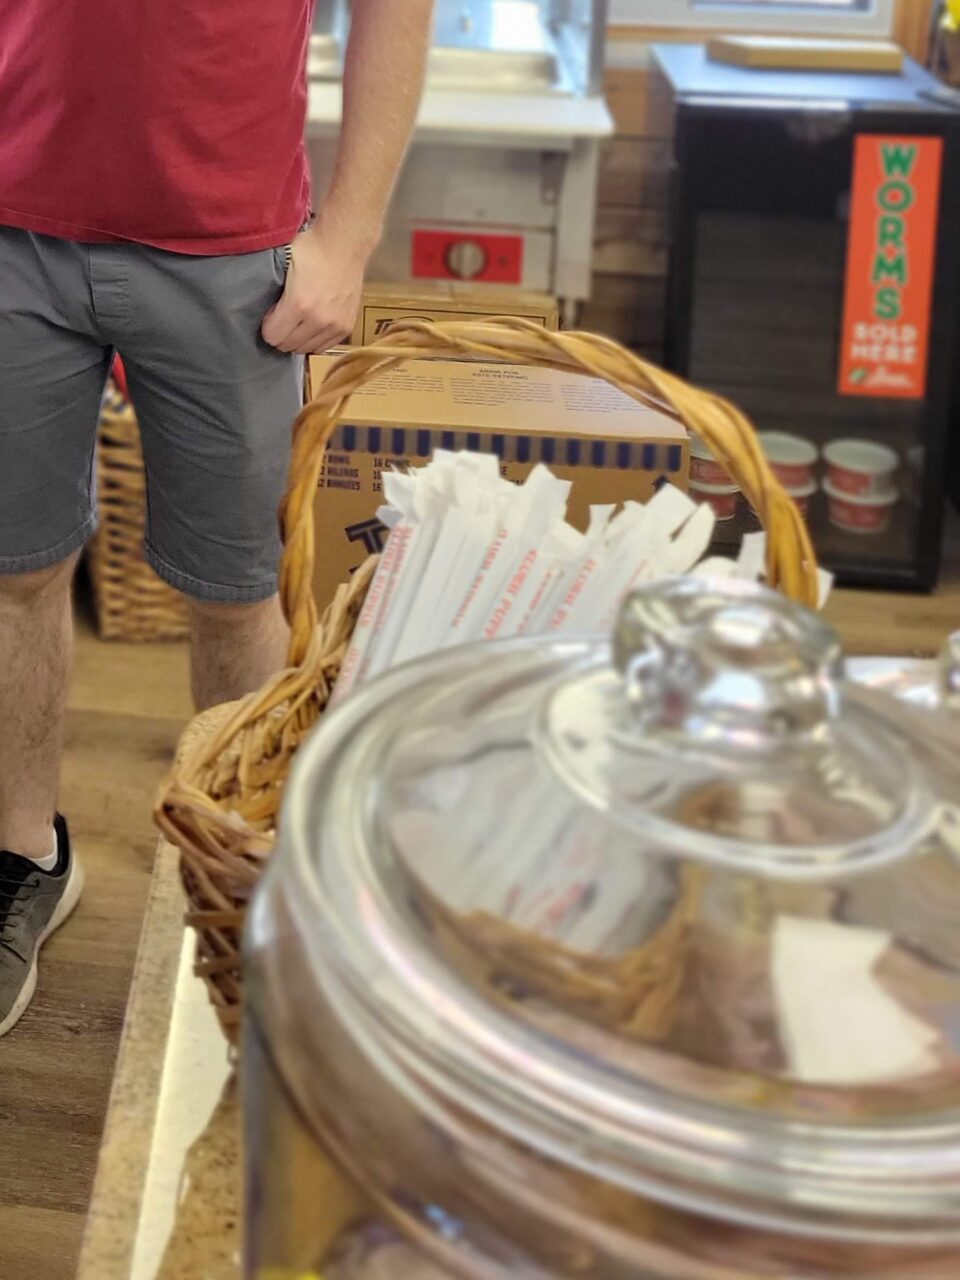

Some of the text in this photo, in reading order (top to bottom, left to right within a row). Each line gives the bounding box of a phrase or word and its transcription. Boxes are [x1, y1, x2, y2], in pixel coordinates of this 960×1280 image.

[870, 142, 917, 320] WORMS
[855, 322, 917, 343] SOLD
[851, 345, 917, 364] HERE
